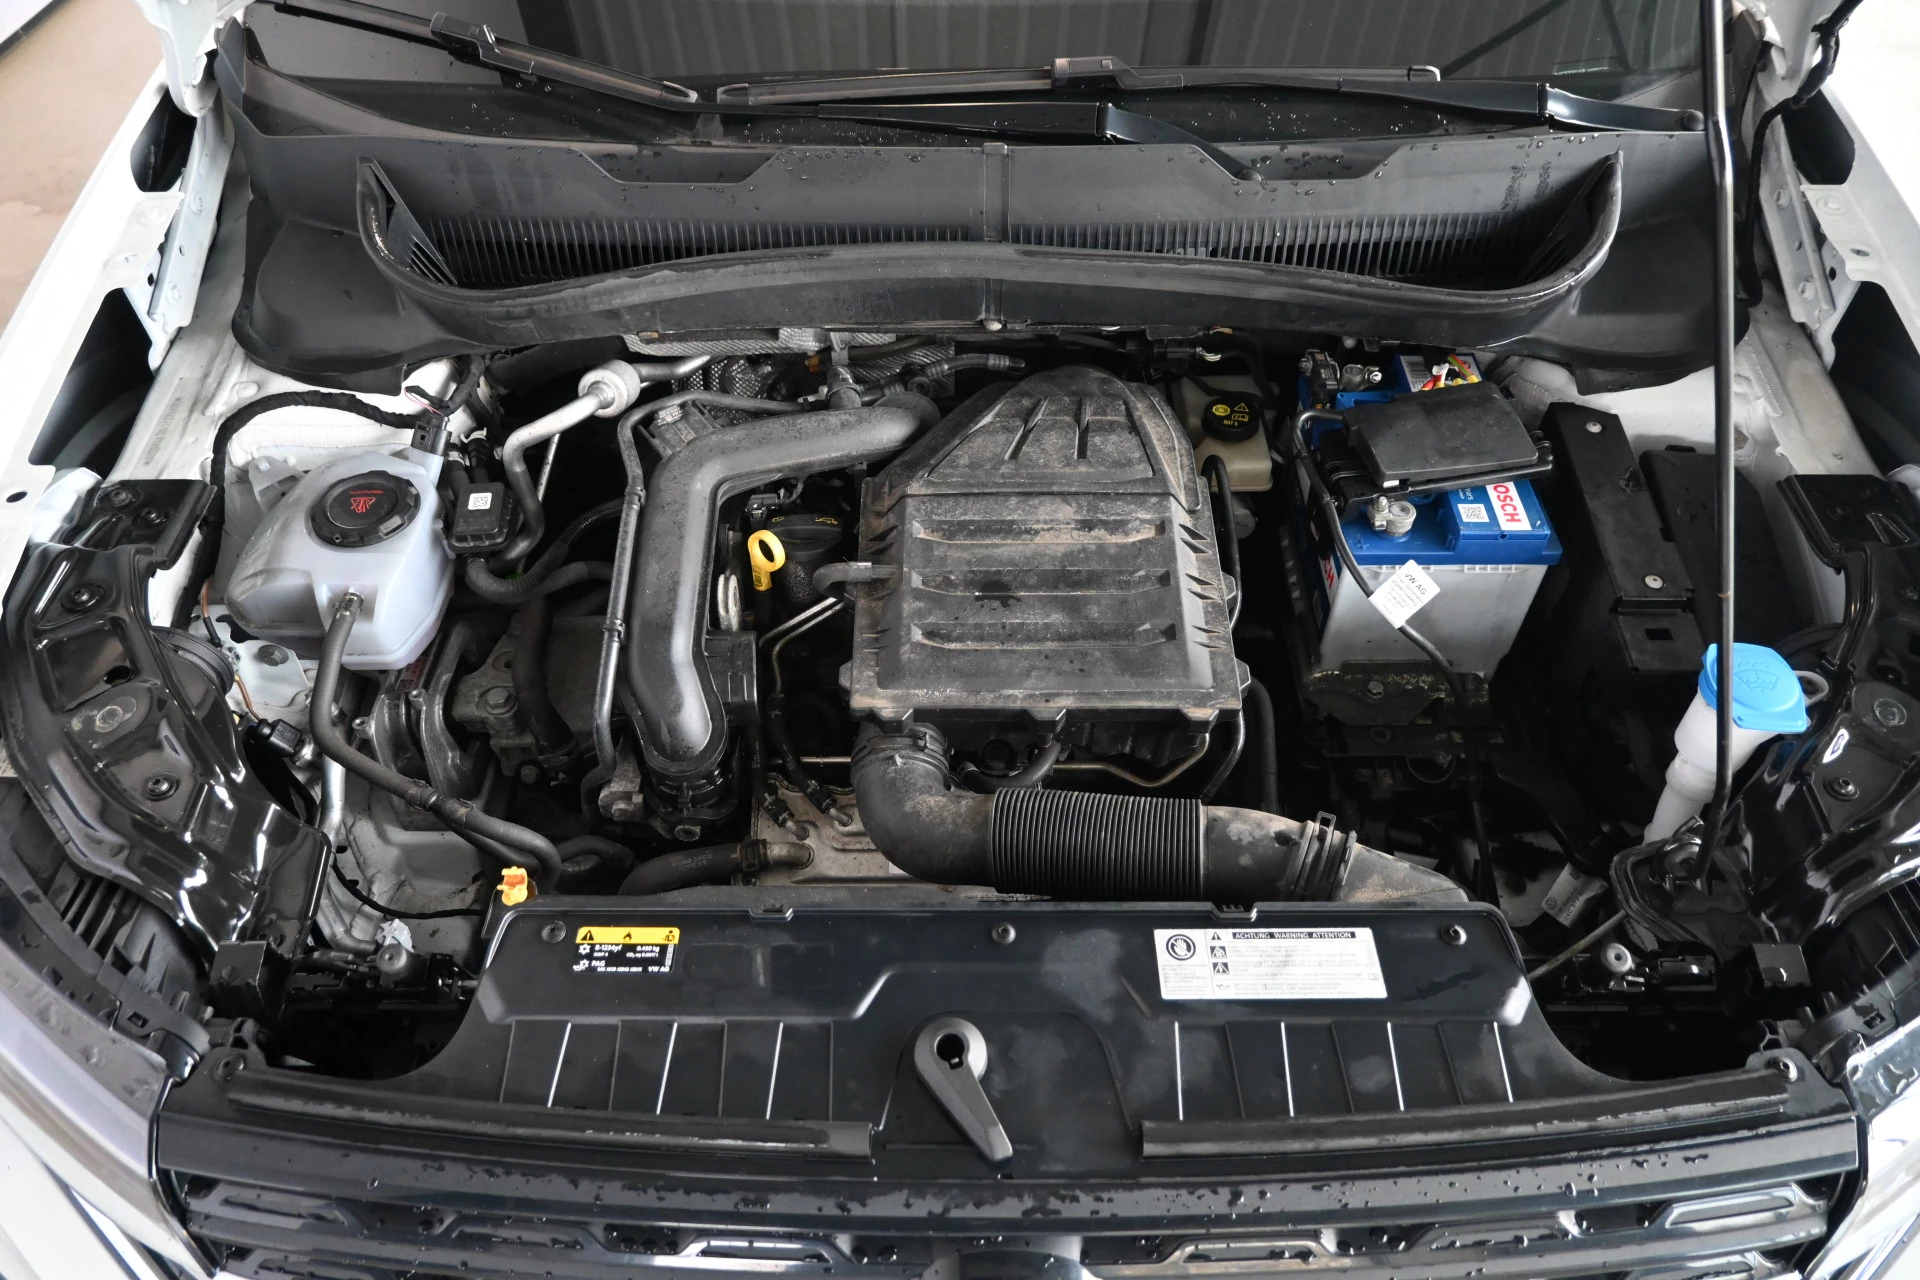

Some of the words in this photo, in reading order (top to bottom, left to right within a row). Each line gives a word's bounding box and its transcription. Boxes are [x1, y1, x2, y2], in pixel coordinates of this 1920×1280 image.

[1493, 484, 1522, 522] OSCH
[1405, 573, 1417, 584] VW
[1415, 584, 1427, 595] AG
[1274, 931, 1309, 939] WARNING
[1312, 931, 1352, 939] ATTENTION
[595, 944, 622, 953] R-1234yf
[652, 945, 660, 953] kg
